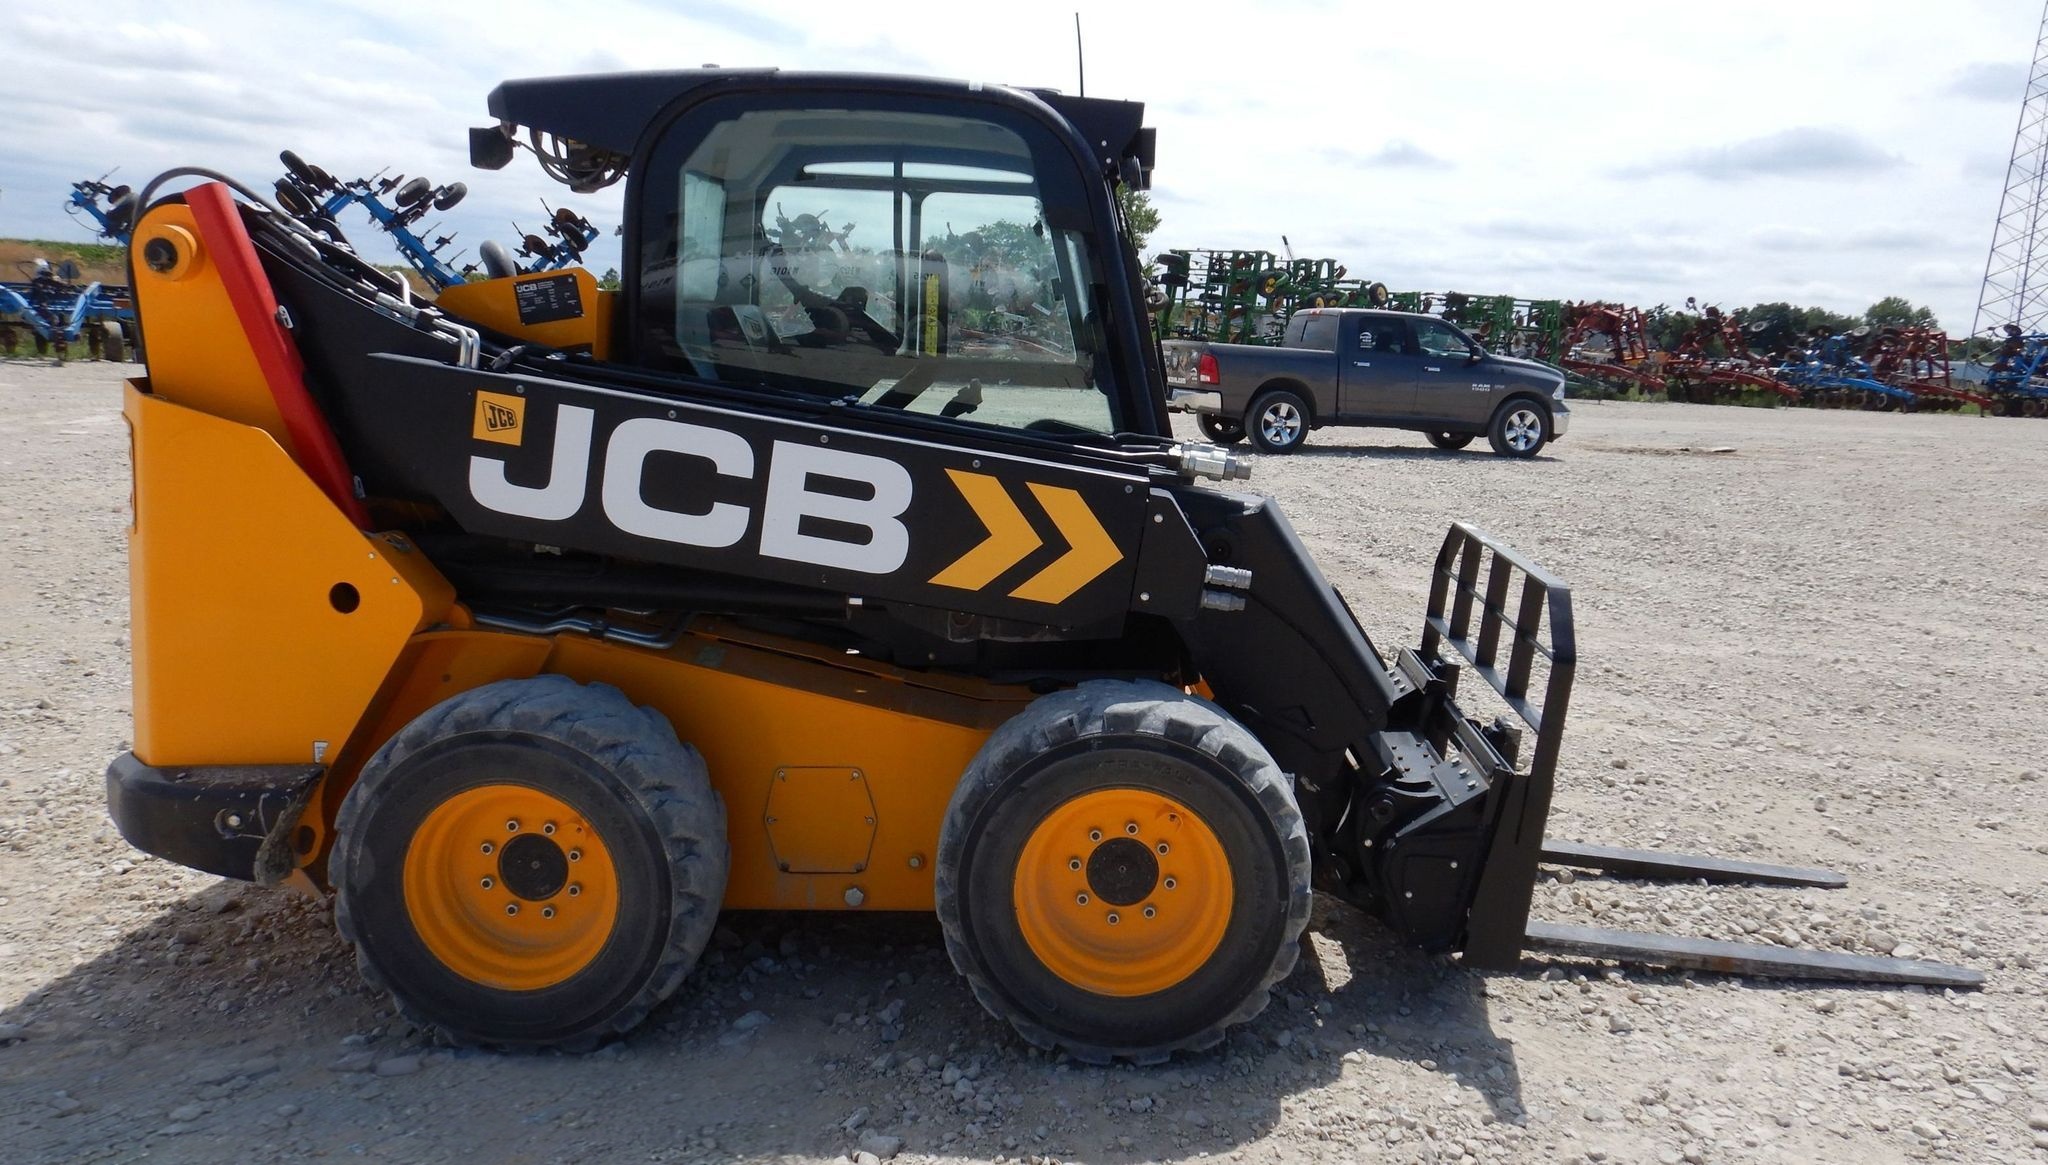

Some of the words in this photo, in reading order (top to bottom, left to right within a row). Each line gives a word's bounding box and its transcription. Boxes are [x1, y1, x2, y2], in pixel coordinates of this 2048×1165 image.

[516, 283, 538, 293] JCB
[488, 405, 515, 428] JCB
[468, 403, 914, 575] JCB
